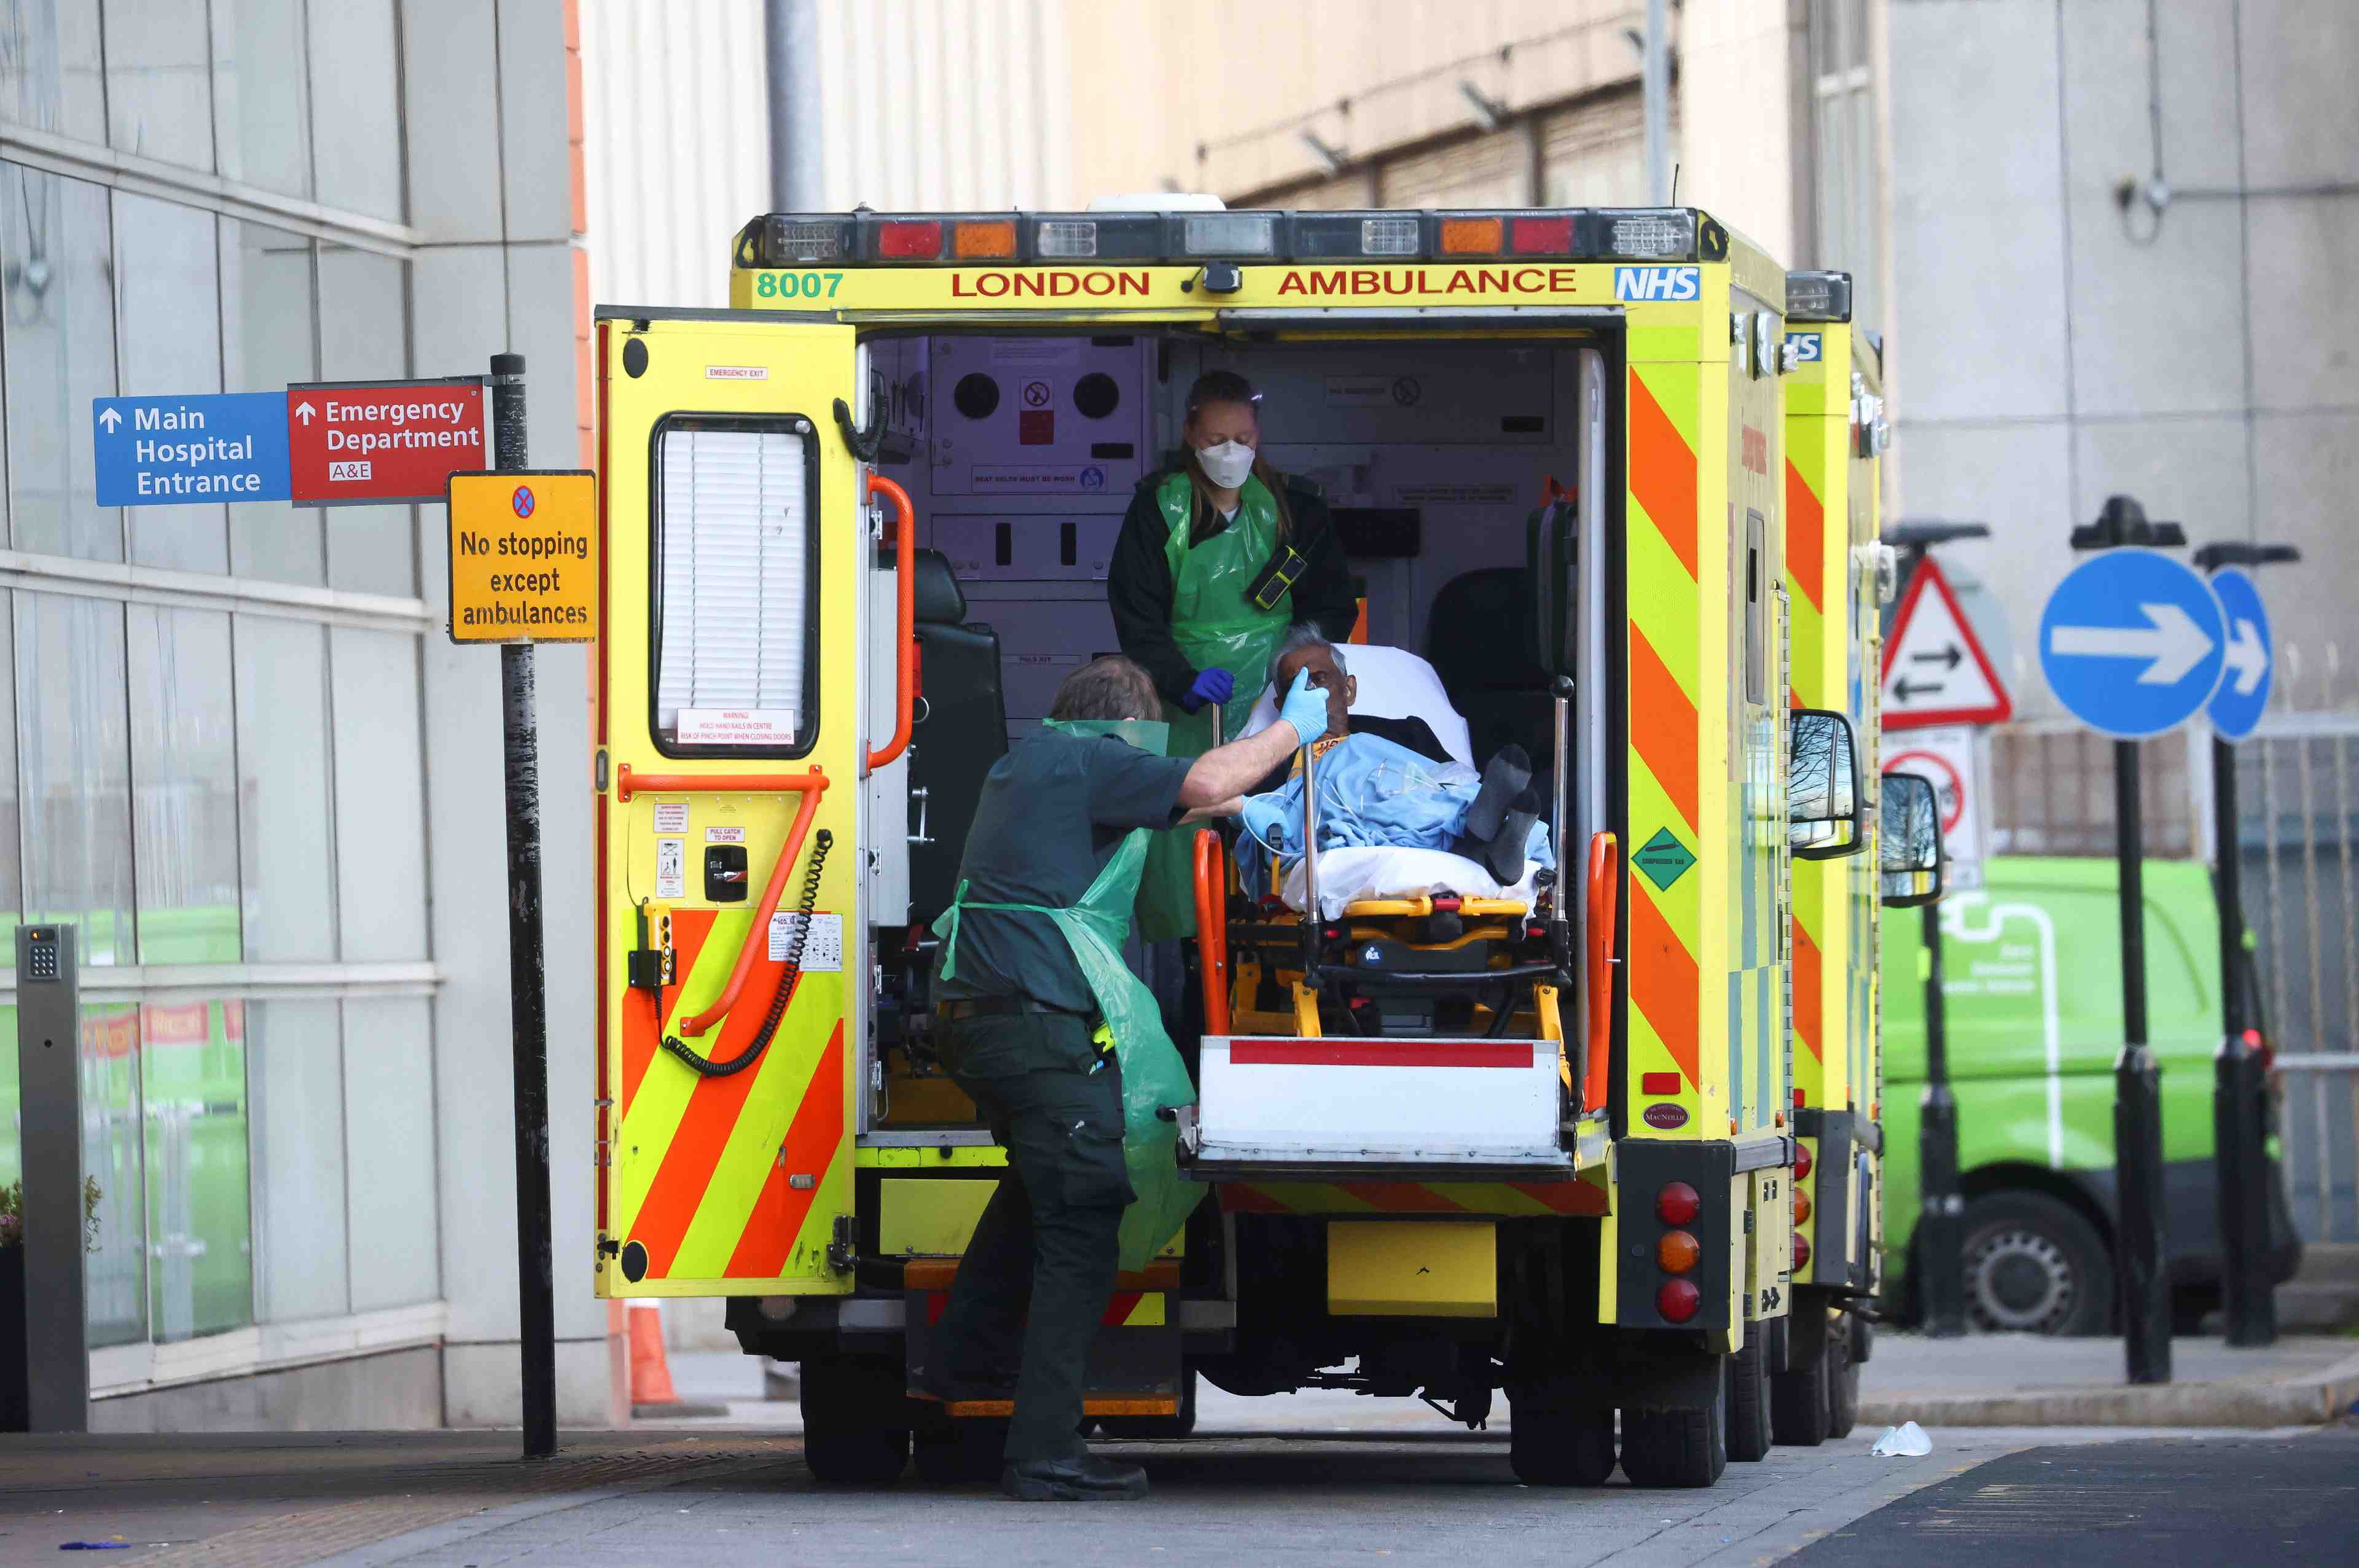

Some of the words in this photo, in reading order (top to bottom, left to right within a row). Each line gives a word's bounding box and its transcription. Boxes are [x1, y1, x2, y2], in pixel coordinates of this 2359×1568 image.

[757, 273, 843, 297] 8007
[952, 271, 1149, 297] LONDON
[1278, 268, 1576, 295] AMBULANCE
[1615, 267, 1699, 300] NHS
[135, 405, 205, 430] Main
[326, 401, 464, 426] Emergency
[136, 435, 252, 467] Hospital
[327, 427, 479, 455] Department
[138, 472, 260, 494] Entrance
[332, 463, 369, 478] A&E
[461, 531, 490, 555] No
[498, 531, 587, 560] stopping
[491, 568, 560, 596] except
[463, 601, 587, 625] ambulances
